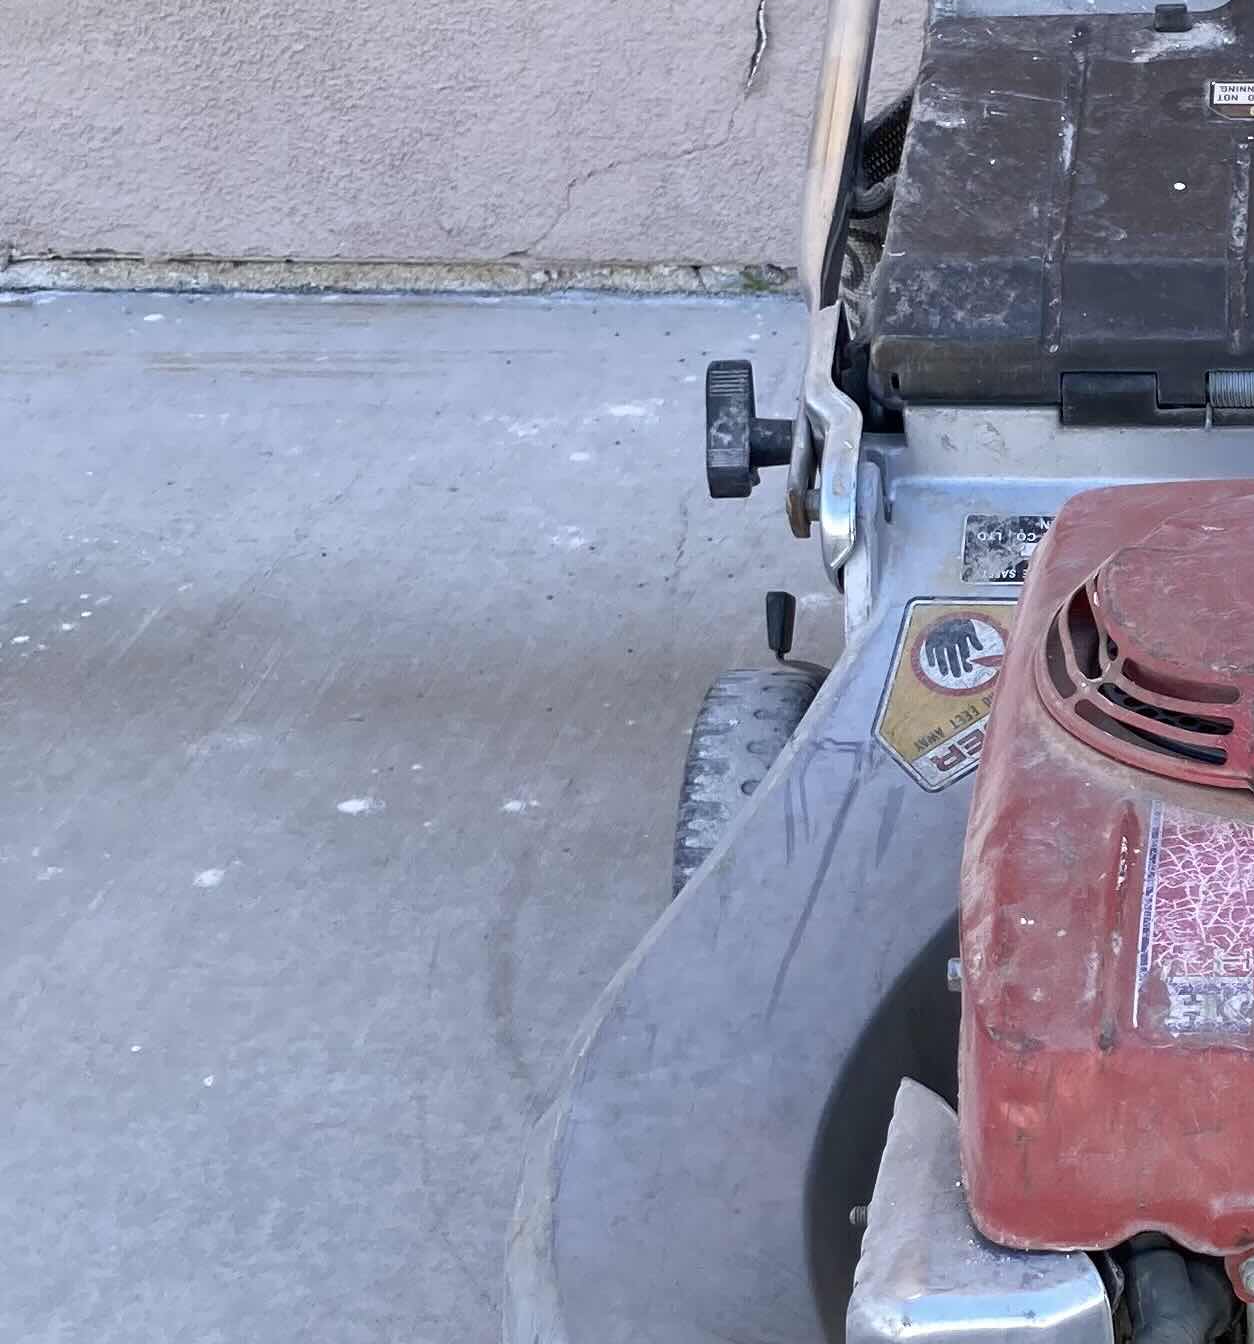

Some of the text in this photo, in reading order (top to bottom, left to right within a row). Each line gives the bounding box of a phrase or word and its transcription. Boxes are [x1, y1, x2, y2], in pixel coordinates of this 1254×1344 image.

[1217, 94, 1239, 102] NOT
[949, 704, 980, 730] FEET
[912, 726, 945, 753] AWAY
